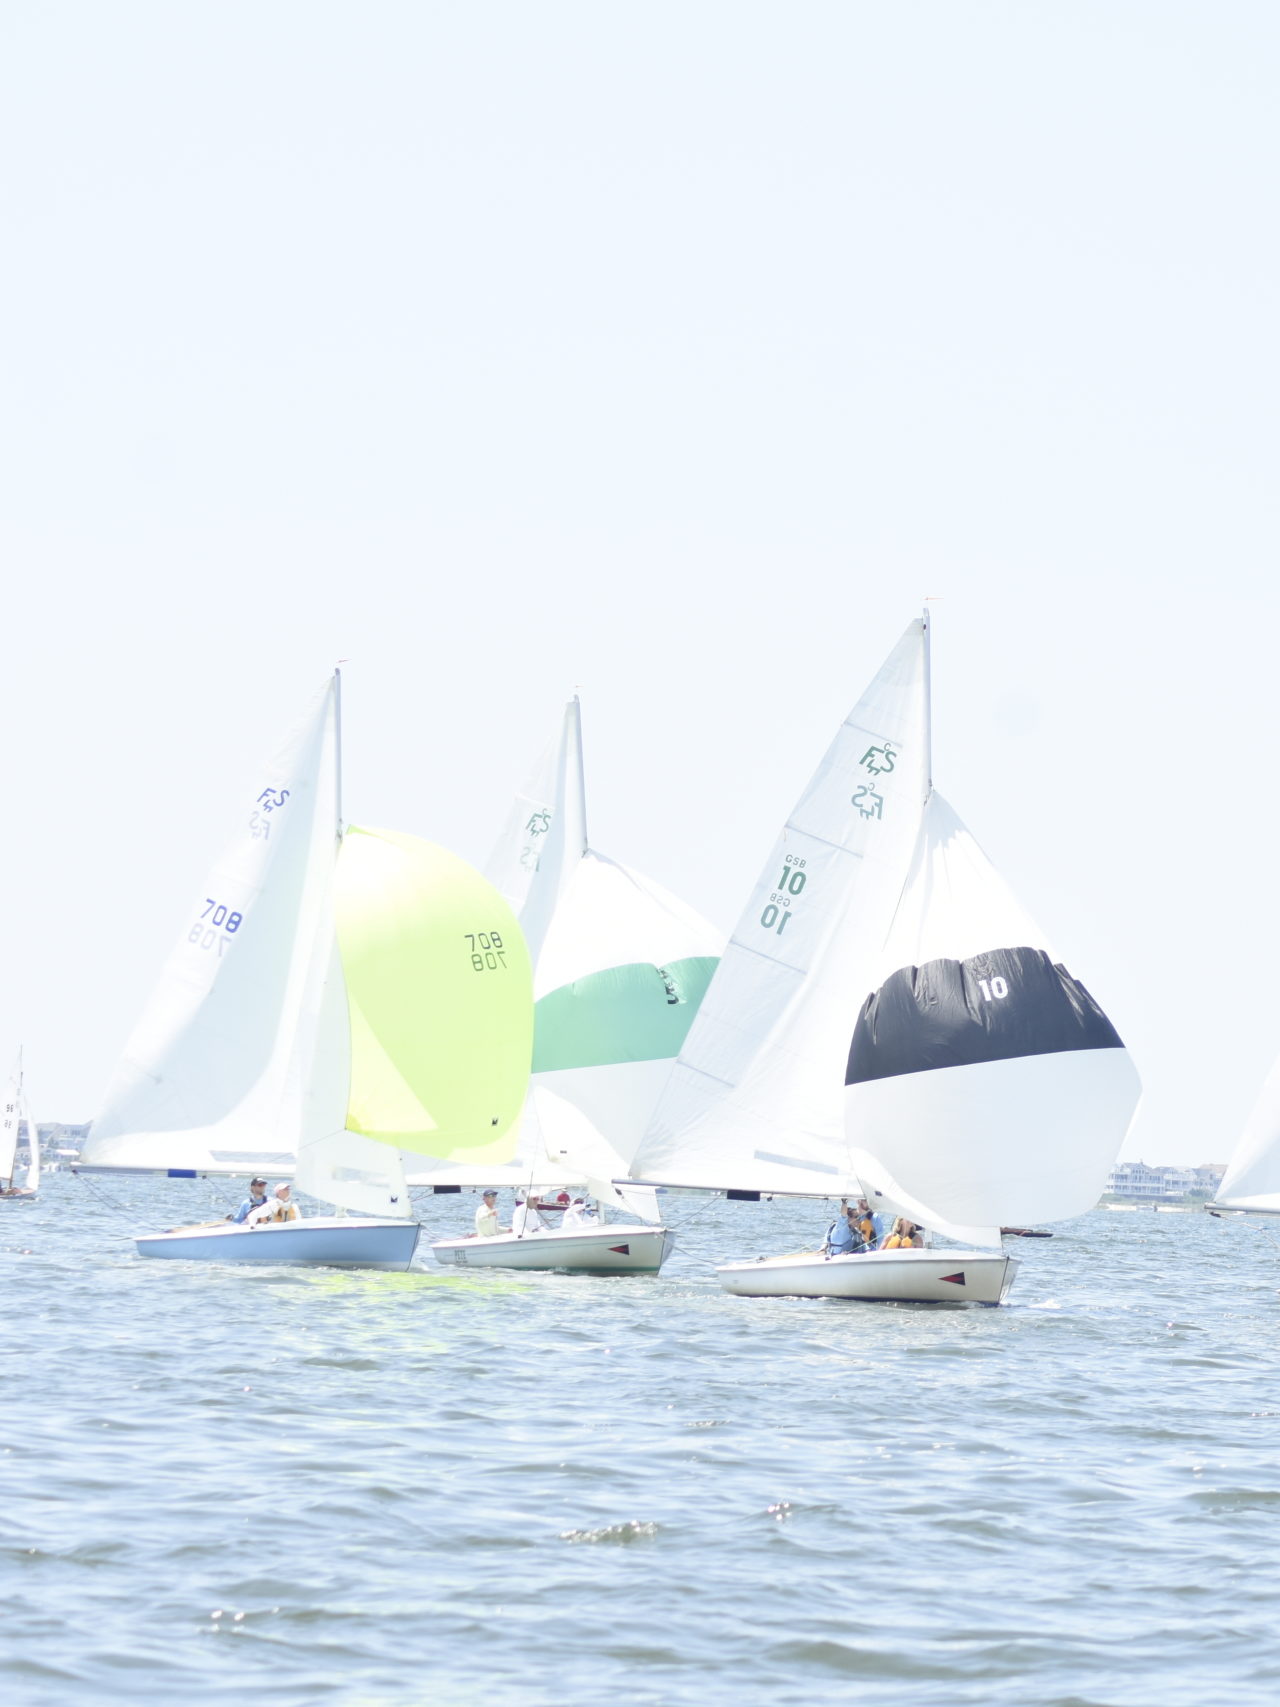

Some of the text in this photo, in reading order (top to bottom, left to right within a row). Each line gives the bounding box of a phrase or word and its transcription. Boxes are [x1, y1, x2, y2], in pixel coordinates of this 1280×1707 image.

[785, 853, 807, 869] GSB
[777, 864, 807, 896] 10
[200, 897, 243, 934] 708
[464, 931, 503, 952] 708
[979, 976, 1008, 1002] 10
